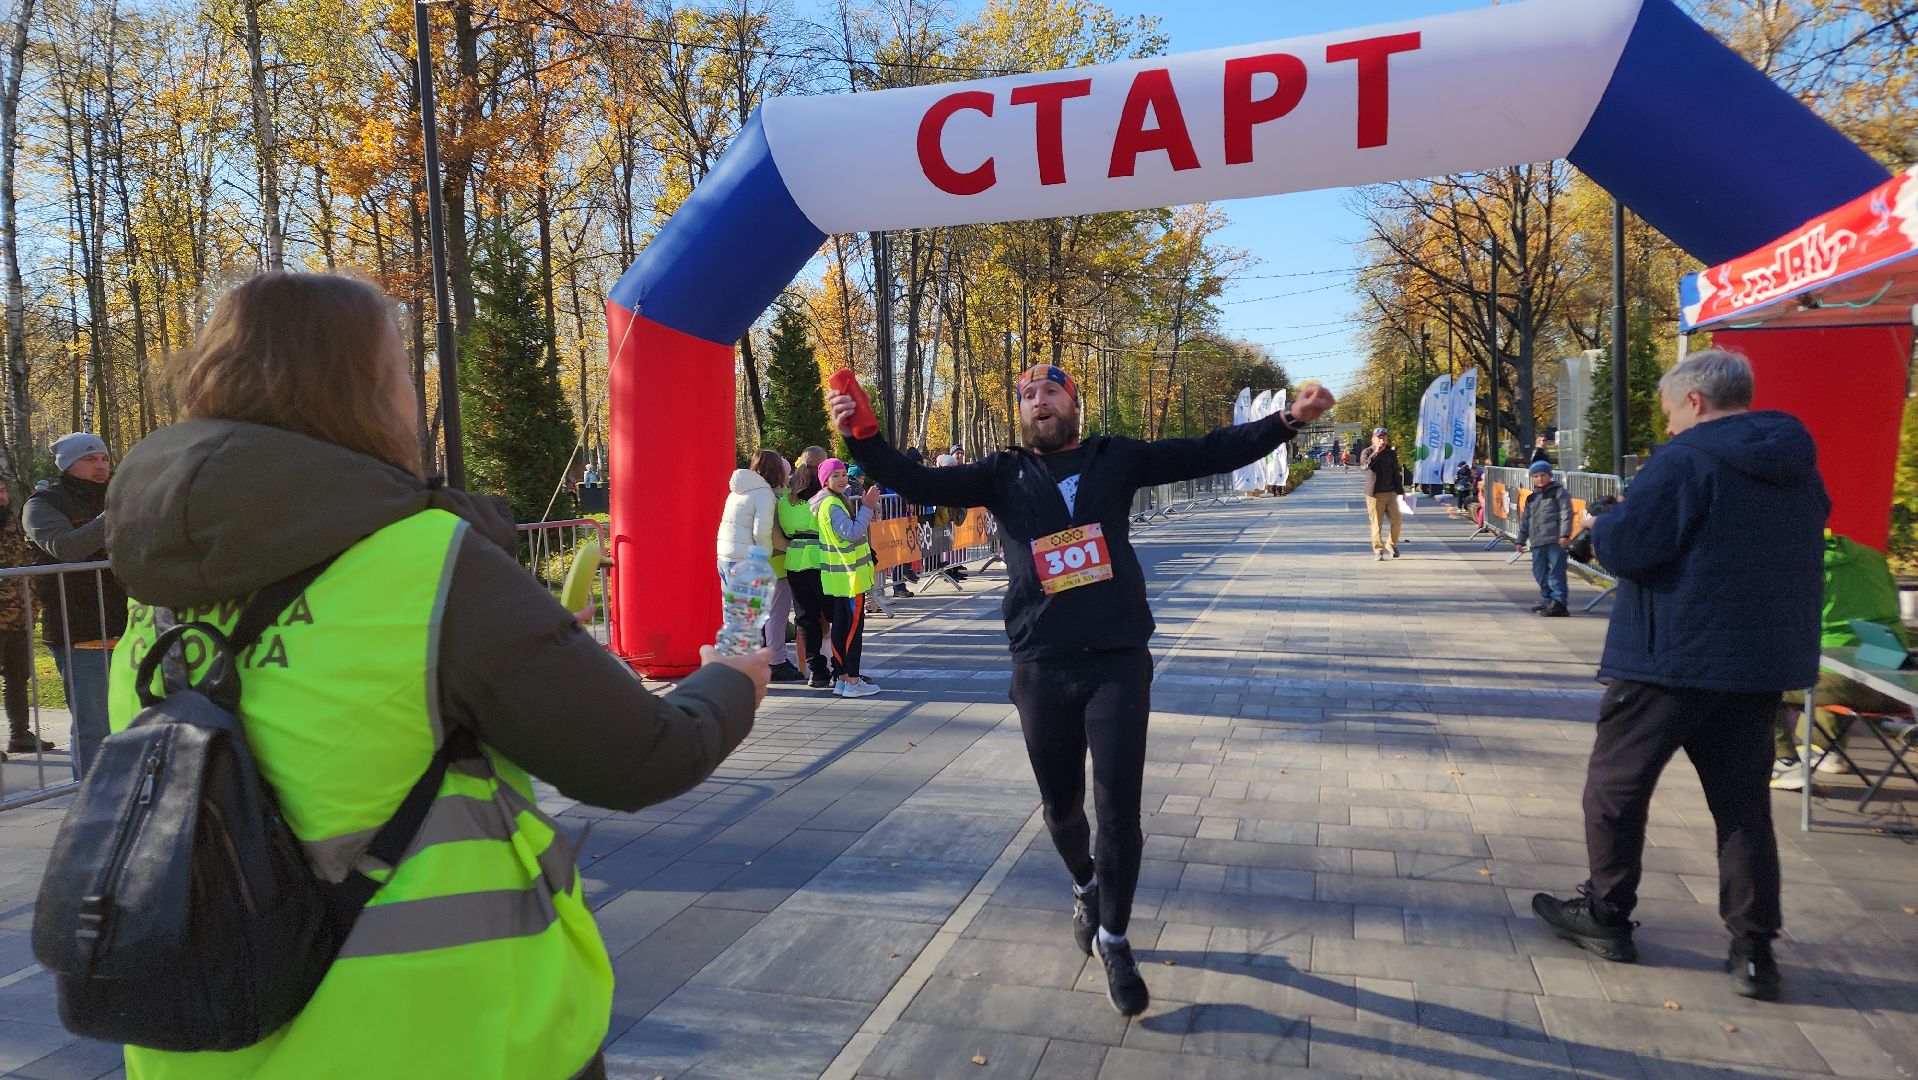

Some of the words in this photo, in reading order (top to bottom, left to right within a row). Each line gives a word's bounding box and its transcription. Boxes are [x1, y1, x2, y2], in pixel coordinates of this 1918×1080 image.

[917, 31, 1421, 195] СТАРТ
[1453, 418, 1465, 447] СПОРТ
[1044, 541, 1101, 575] 301
[130, 633, 289, 671] СОТА
